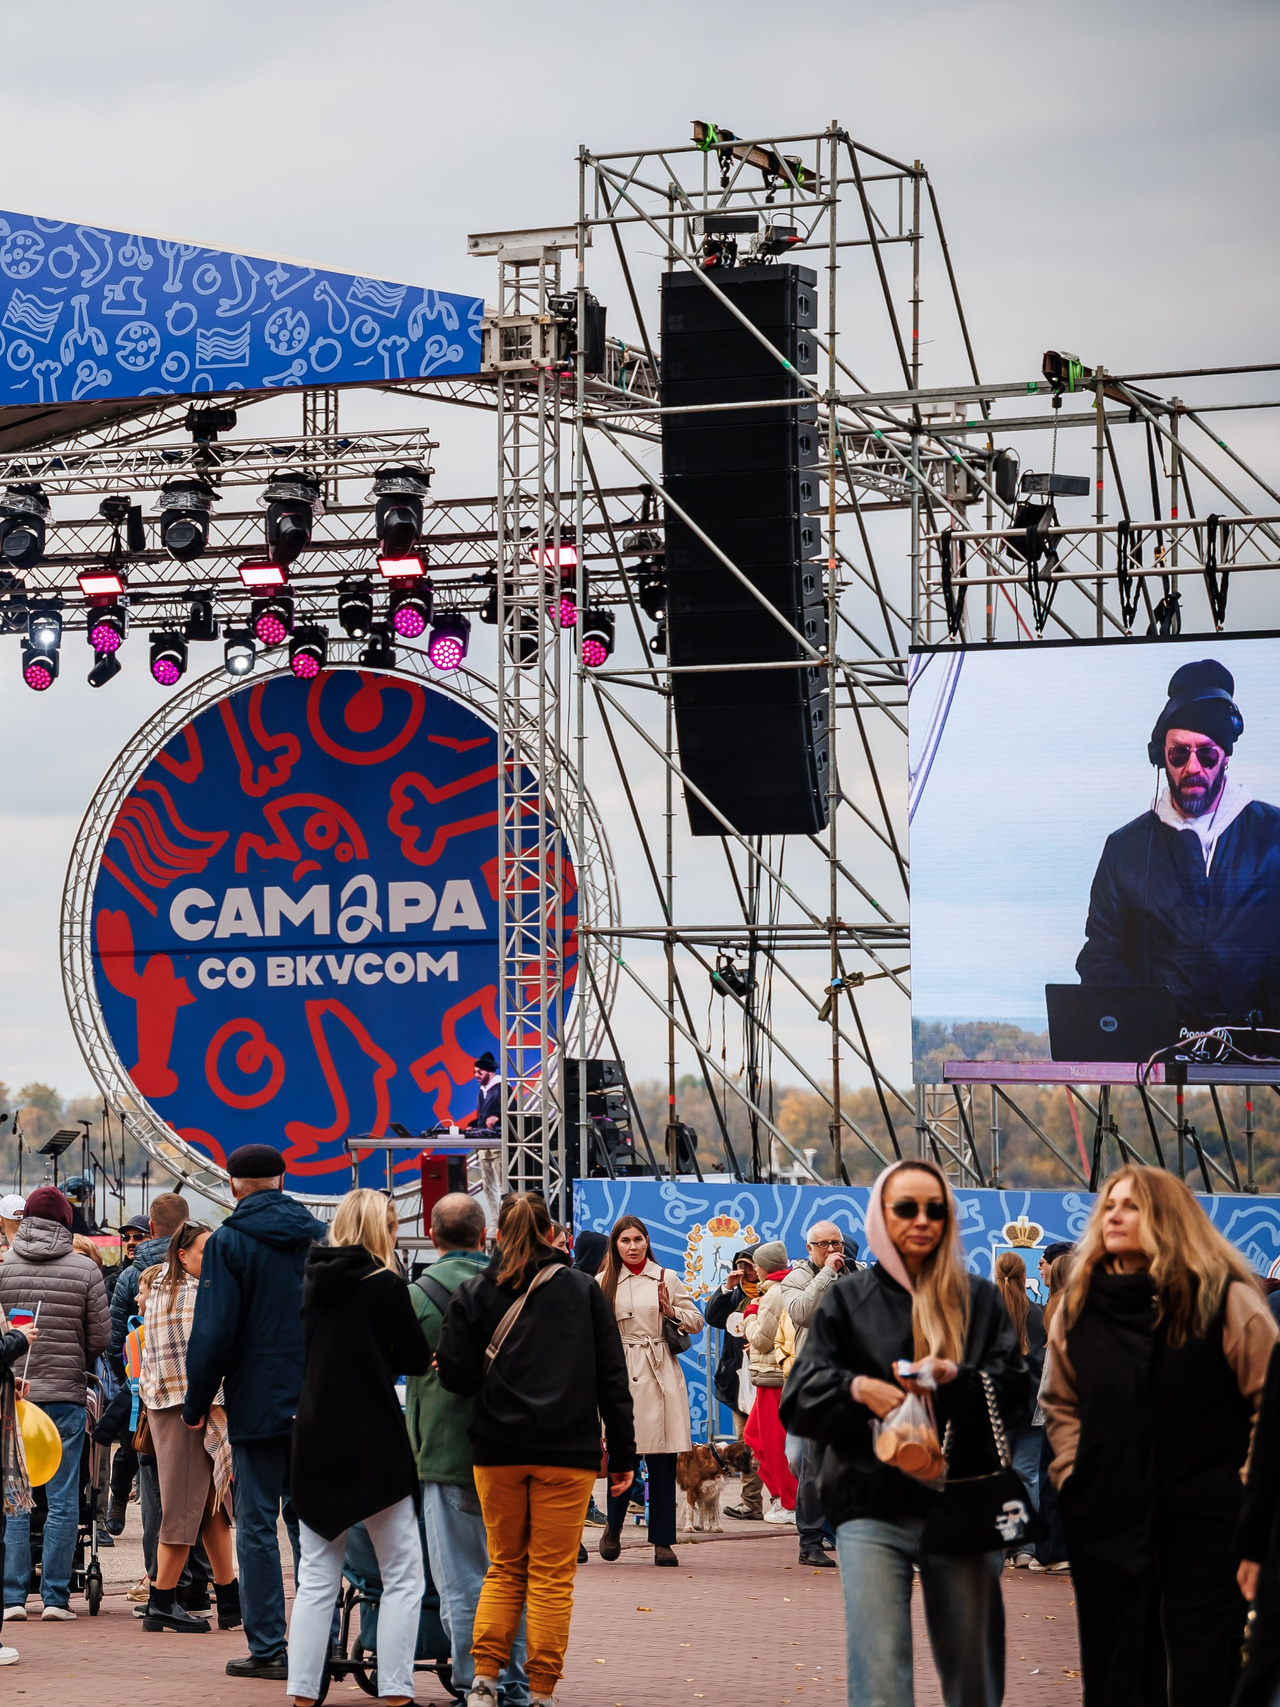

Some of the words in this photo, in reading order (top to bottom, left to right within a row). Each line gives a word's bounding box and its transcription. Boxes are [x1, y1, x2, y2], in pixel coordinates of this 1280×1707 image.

[169, 874, 487, 943] САМАРА
[197, 956, 256, 990] СО
[266, 951, 459, 987] ВКУСОМ
